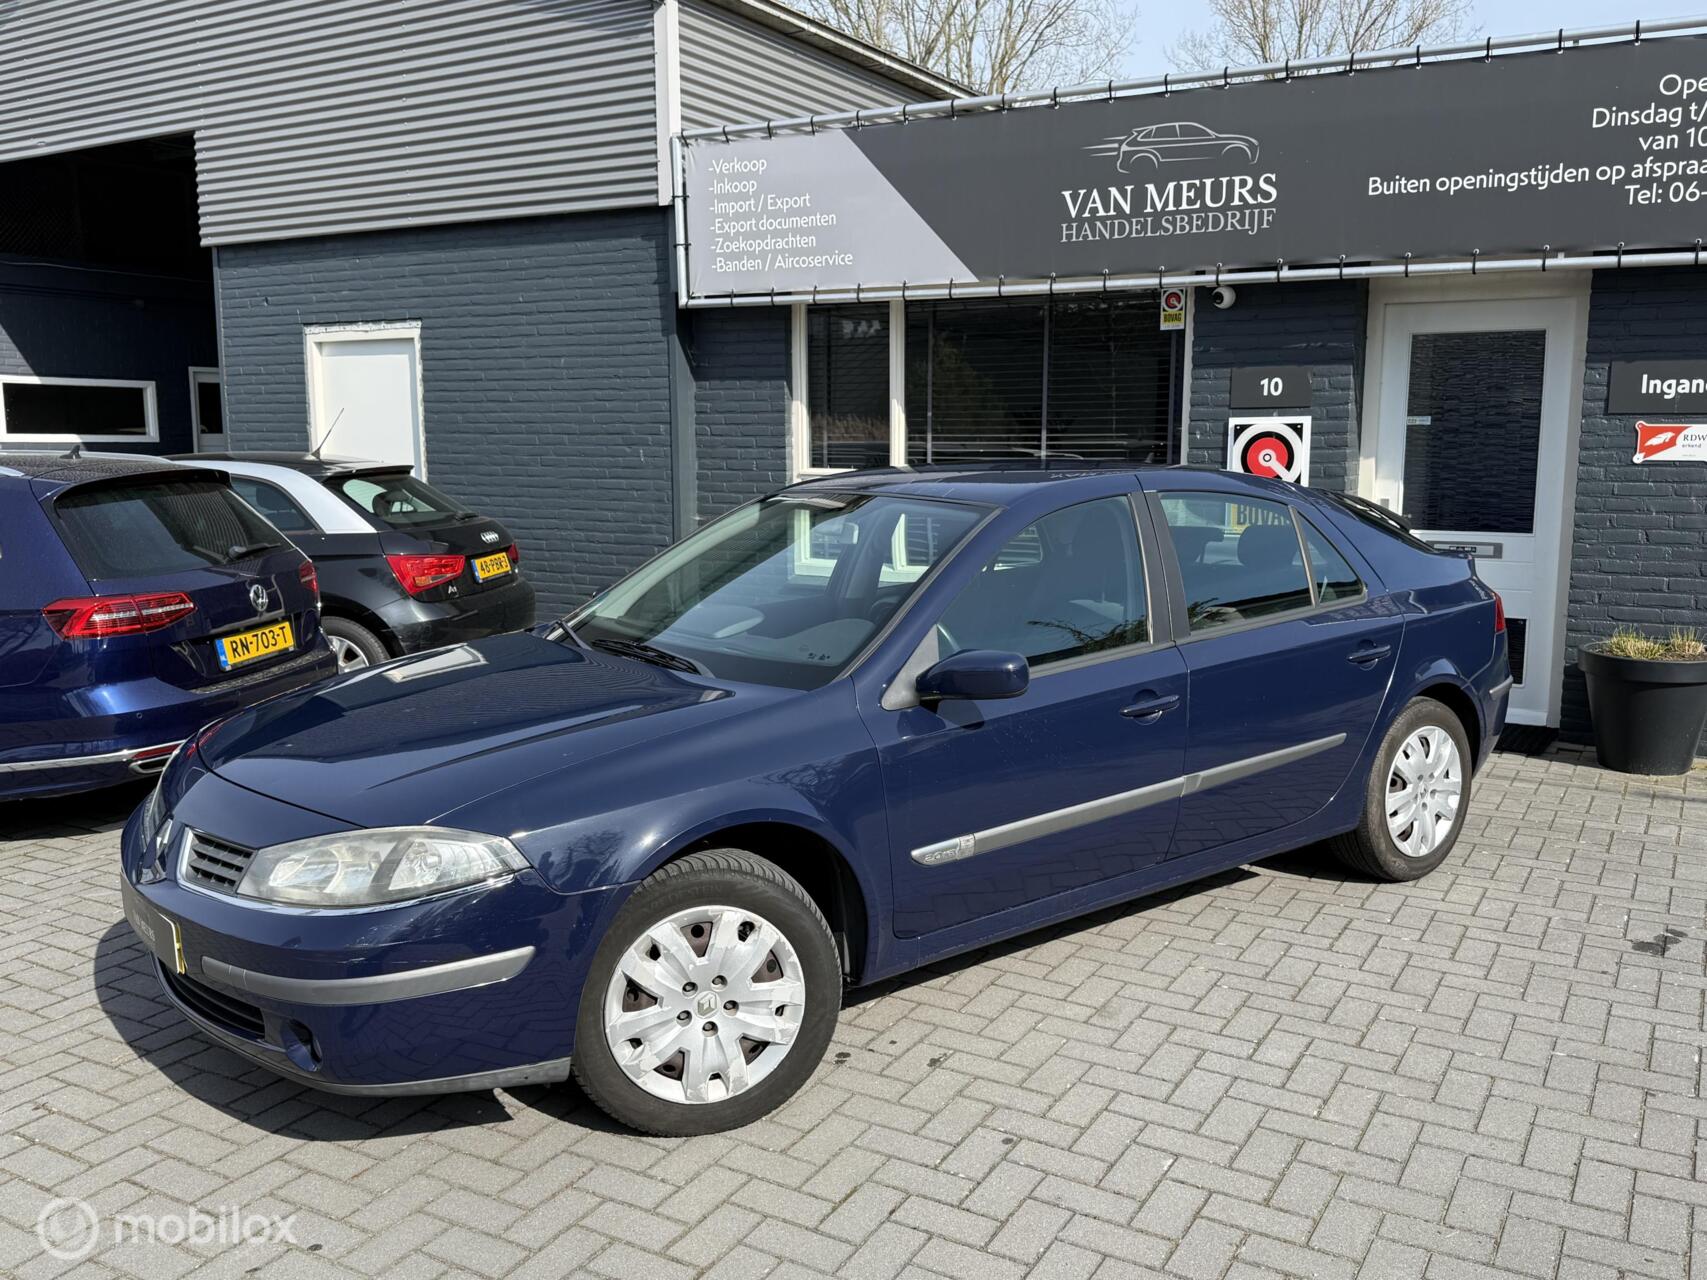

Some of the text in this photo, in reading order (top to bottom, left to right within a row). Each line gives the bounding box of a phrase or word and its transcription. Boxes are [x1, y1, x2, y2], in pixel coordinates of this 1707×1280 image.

[1592, 103, 1683, 128] Dinsdag
[1639, 134, 1679, 151] van
[708, 157, 767, 175] -Verkoop
[708, 178, 757, 195] -Inkoop
[1368, 175, 1430, 196] Buiten
[1436, 163, 1590, 195] openingstijden
[1596, 165, 1626, 186] op
[709, 197, 755, 217] -Import
[767, 193, 811, 211] Export
[1061, 173, 1278, 219] VAN MEURS
[1624, 183, 1663, 205] Tel:
[710, 212, 836, 236] -Export documenten
[1060, 208, 1276, 242] HANDELSBEDRIJF
[711, 233, 816, 253] -Zoekopdrachten
[711, 254, 762, 273] -Banden
[774, 250, 853, 270] Aircoservice
[1163, 313, 1182, 323] BOVAG
[1260, 377, 1283, 396] 10
[1641, 373, 1707, 399] Ingan
[230, 626, 287, 658] RN-703-T
